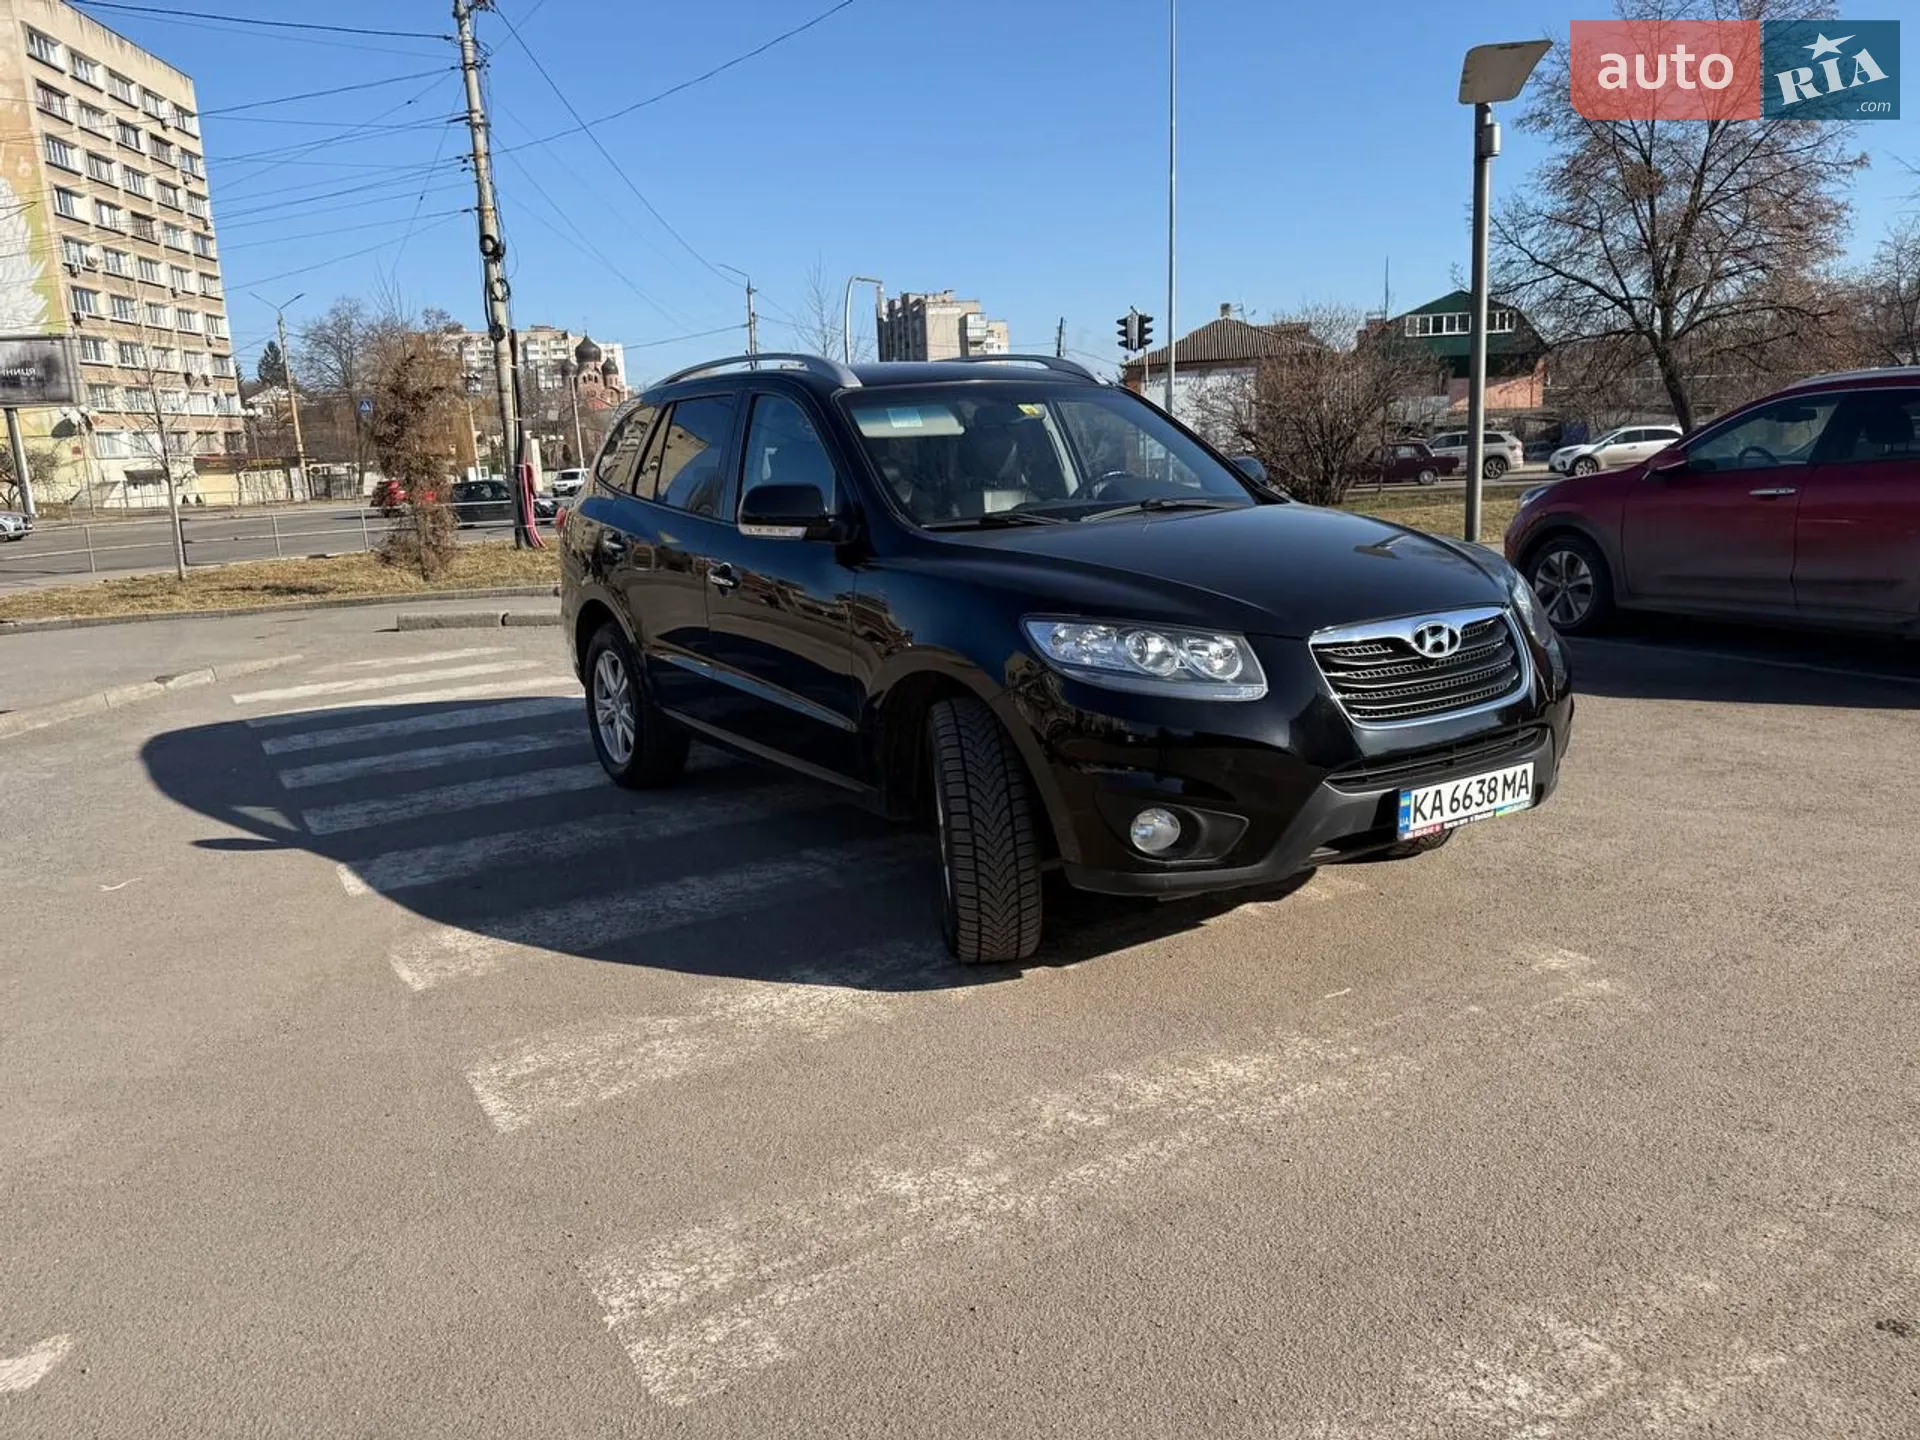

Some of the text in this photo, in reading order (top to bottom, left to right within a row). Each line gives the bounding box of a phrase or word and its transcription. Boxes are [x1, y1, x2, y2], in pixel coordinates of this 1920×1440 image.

[1412, 789, 1444, 824] KA
[1449, 776, 1499, 814] 6638
[1501, 768, 1530, 801] MA
